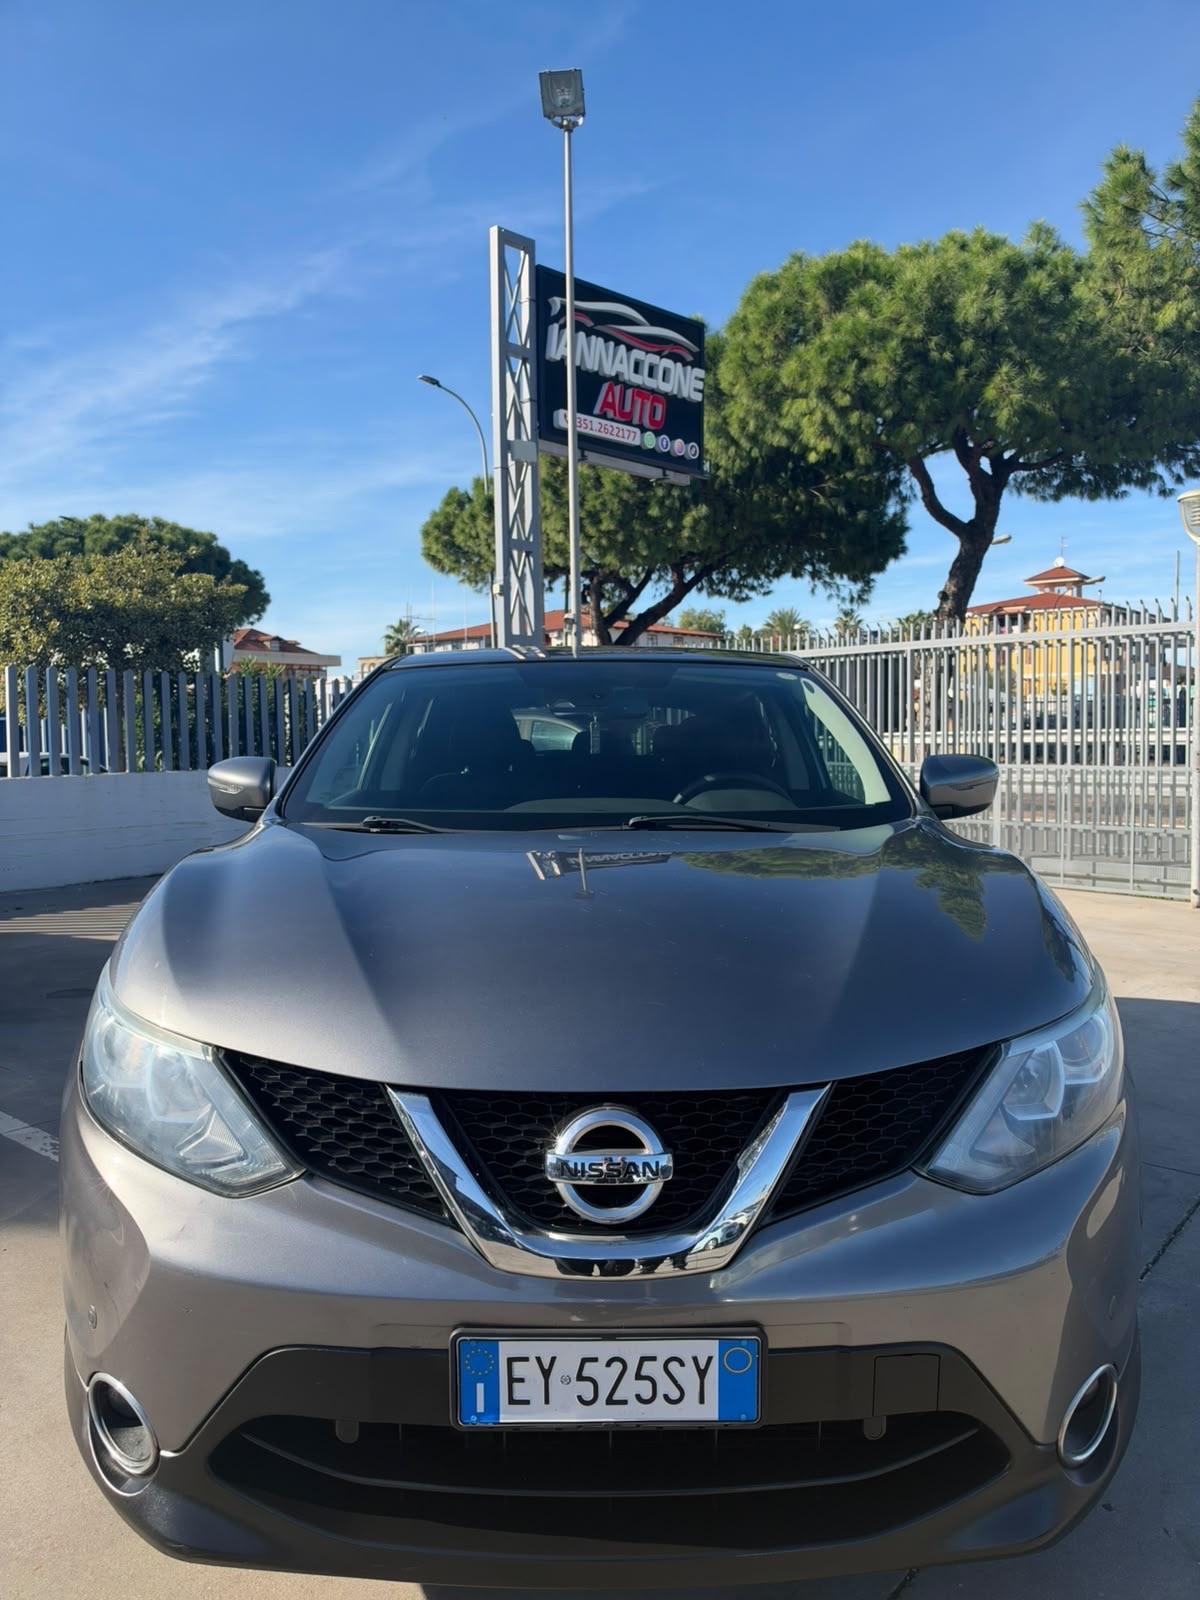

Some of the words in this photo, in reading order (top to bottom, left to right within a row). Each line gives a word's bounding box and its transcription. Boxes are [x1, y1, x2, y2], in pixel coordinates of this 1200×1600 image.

[593, 381, 666, 430] AUTO
[576, 416, 637, 442] 351.2622177
[559, 1160, 660, 1180] NISSAN
[506, 1356, 557, 1406] EY
[576, 1355, 714, 1406] 525SY
